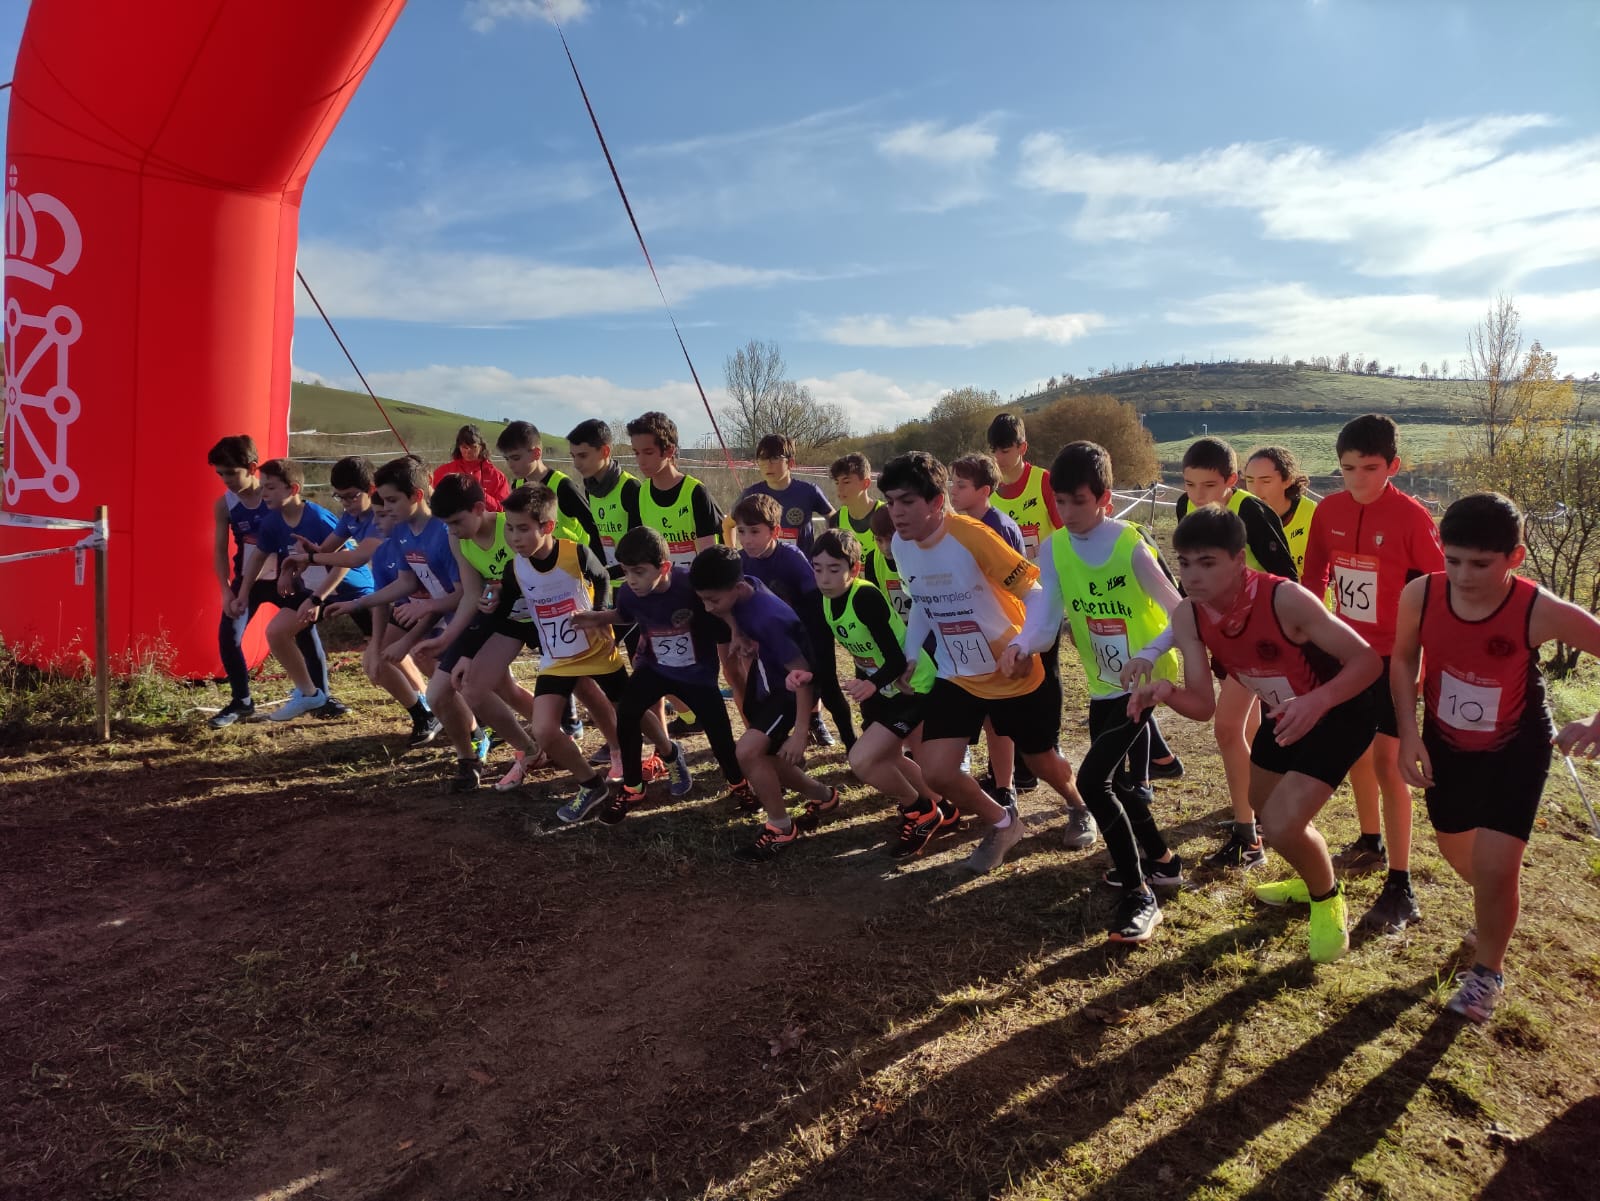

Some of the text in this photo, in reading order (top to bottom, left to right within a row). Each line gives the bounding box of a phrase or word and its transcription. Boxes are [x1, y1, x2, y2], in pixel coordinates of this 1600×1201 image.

[1339, 575, 1374, 610] 145
[542, 618, 577, 648] 76
[658, 636, 689, 656] 58
[953, 638, 986, 665] 84
[1448, 694, 1484, 722] 10
